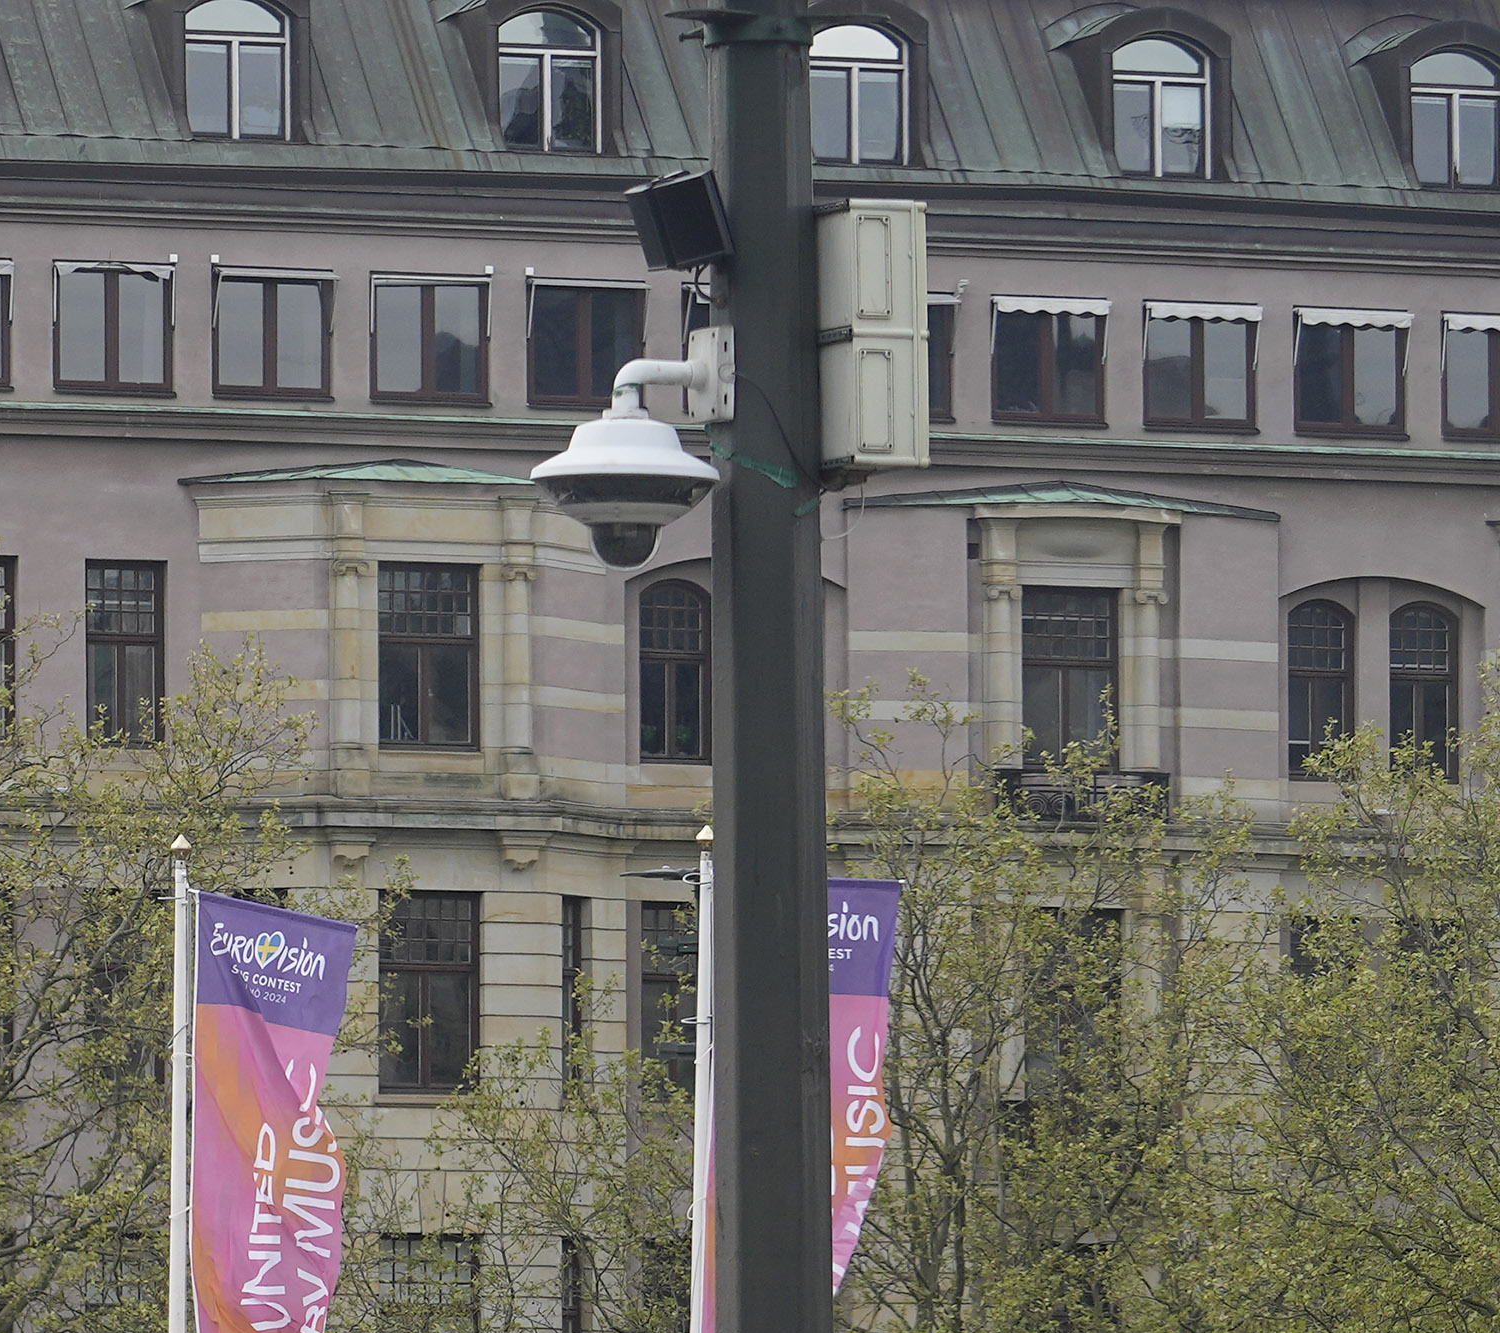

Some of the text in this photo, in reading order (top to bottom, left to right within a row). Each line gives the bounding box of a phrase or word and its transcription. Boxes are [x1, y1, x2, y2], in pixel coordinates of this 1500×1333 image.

[251, 972, 302, 994] CONTEST
[262, 991, 288, 1006] 2024
[239, 1121, 292, 1332] UNITED
